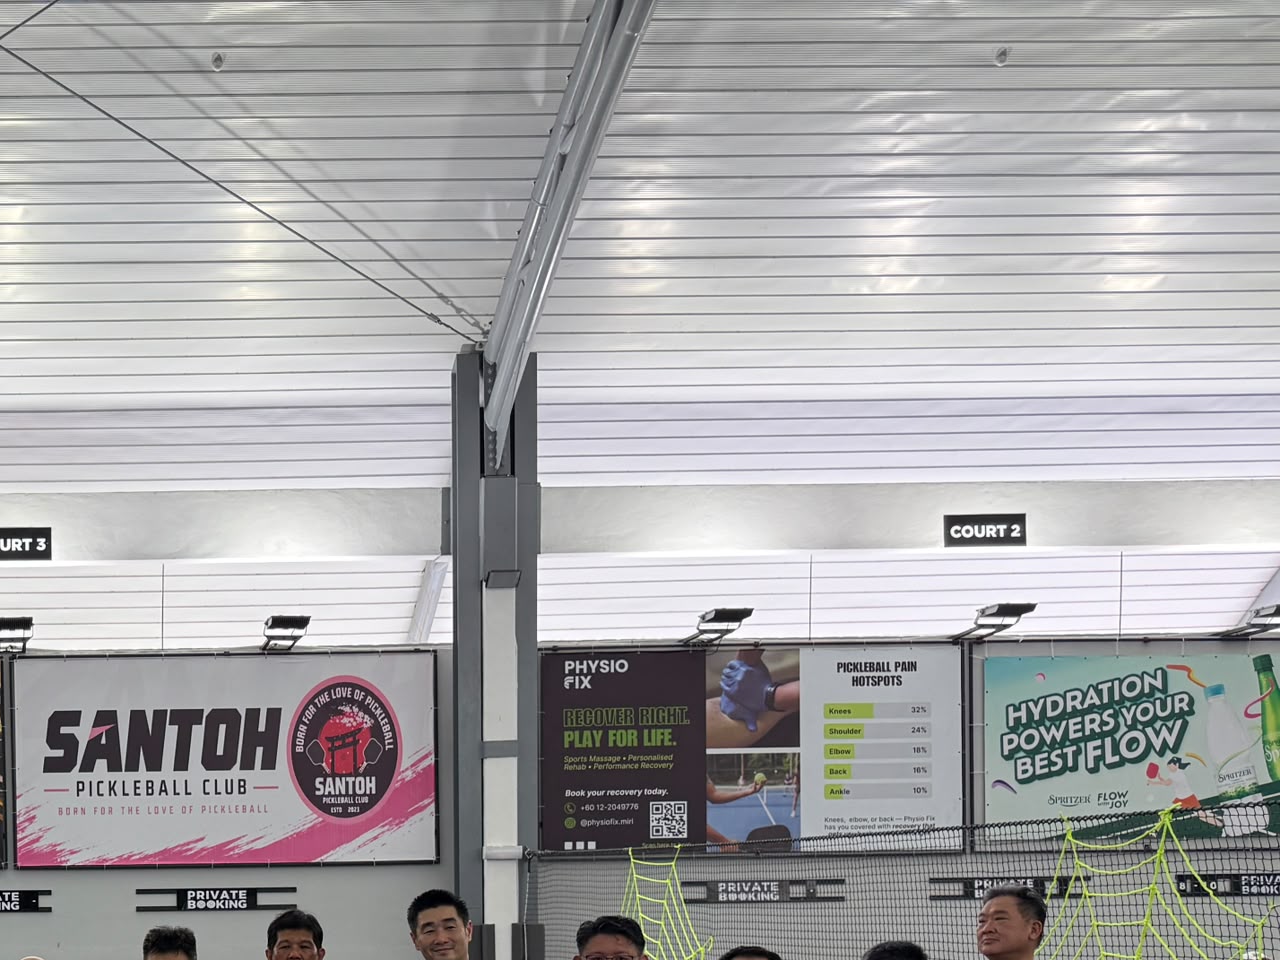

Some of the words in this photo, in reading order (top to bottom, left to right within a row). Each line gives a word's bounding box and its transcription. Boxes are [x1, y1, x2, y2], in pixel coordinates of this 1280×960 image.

[949, 524, 1007, 538] COURT
[1010, 524, 1022, 538] 2
[36, 538, 47, 551] 3
[564, 659, 629, 674] PHYSIO
[836, 661, 891, 673] PICKLEBALL
[894, 661, 917, 672] PAIN
[564, 675, 592, 689] FIX
[851, 675, 903, 687] HOTSPOTS
[1007, 668, 1166, 728] HYDRATION
[563, 707, 634, 727] RECOVER
[638, 706, 691, 726] RIGHT.
[829, 707, 852, 715] Knees
[911, 706, 927, 714] 32%
[295, 724, 308, 753] BORN
[302, 704, 318, 725] FOR
[314, 691, 331, 708] THE
[331, 686, 352, 699] LOVE
[353, 689, 366, 701] OF
[365, 695, 394, 751] PICKLEBALL
[1002, 708, 1115, 756] POWERS
[1119, 692, 1191, 726] YOUR
[829, 727, 861, 735] Shoulder
[42, 707, 282, 774] SANTOH
[563, 730, 603, 748] PLAY
[608, 729, 638, 747] FOR
[643, 728, 677, 746] LIFE.
[1016, 745, 1080, 780] BEST
[1086, 718, 1184, 769] FLOW
[564, 755, 588, 763] Sports
[589, 755, 621, 763] Massage
[627, 753, 674, 761] Personalised
[640, 762, 674, 770] Recovery
[75, 779, 193, 797] PICKLEBALL
[202, 778, 248, 796] CLUB
[314, 776, 376, 796] SANTOH
[829, 787, 851, 795] Ankle
[565, 789, 585, 797] Book
[586, 790, 605, 798] your
[606, 788, 642, 797] recovery
[644, 788, 669, 796] today.
[1097, 790, 1129, 801] FLOW
[322, 796, 354, 804] PICKLEBALL
[1109, 799, 1129, 809] JOY
[58, 806, 87, 816] BORN
[93, 806, 114, 815] FOR
[121, 806, 140, 815] THE
[147, 805, 174, 815] LOVE
[182, 805, 194, 814] OF
[201, 804, 269, 814] PICKLEBALL
[581, 803, 595, 811] +60
[717, 881, 779, 893] PRIVATE
[187, 890, 247, 900] PRIVATE
[187, 900, 247, 909] BOOKING
